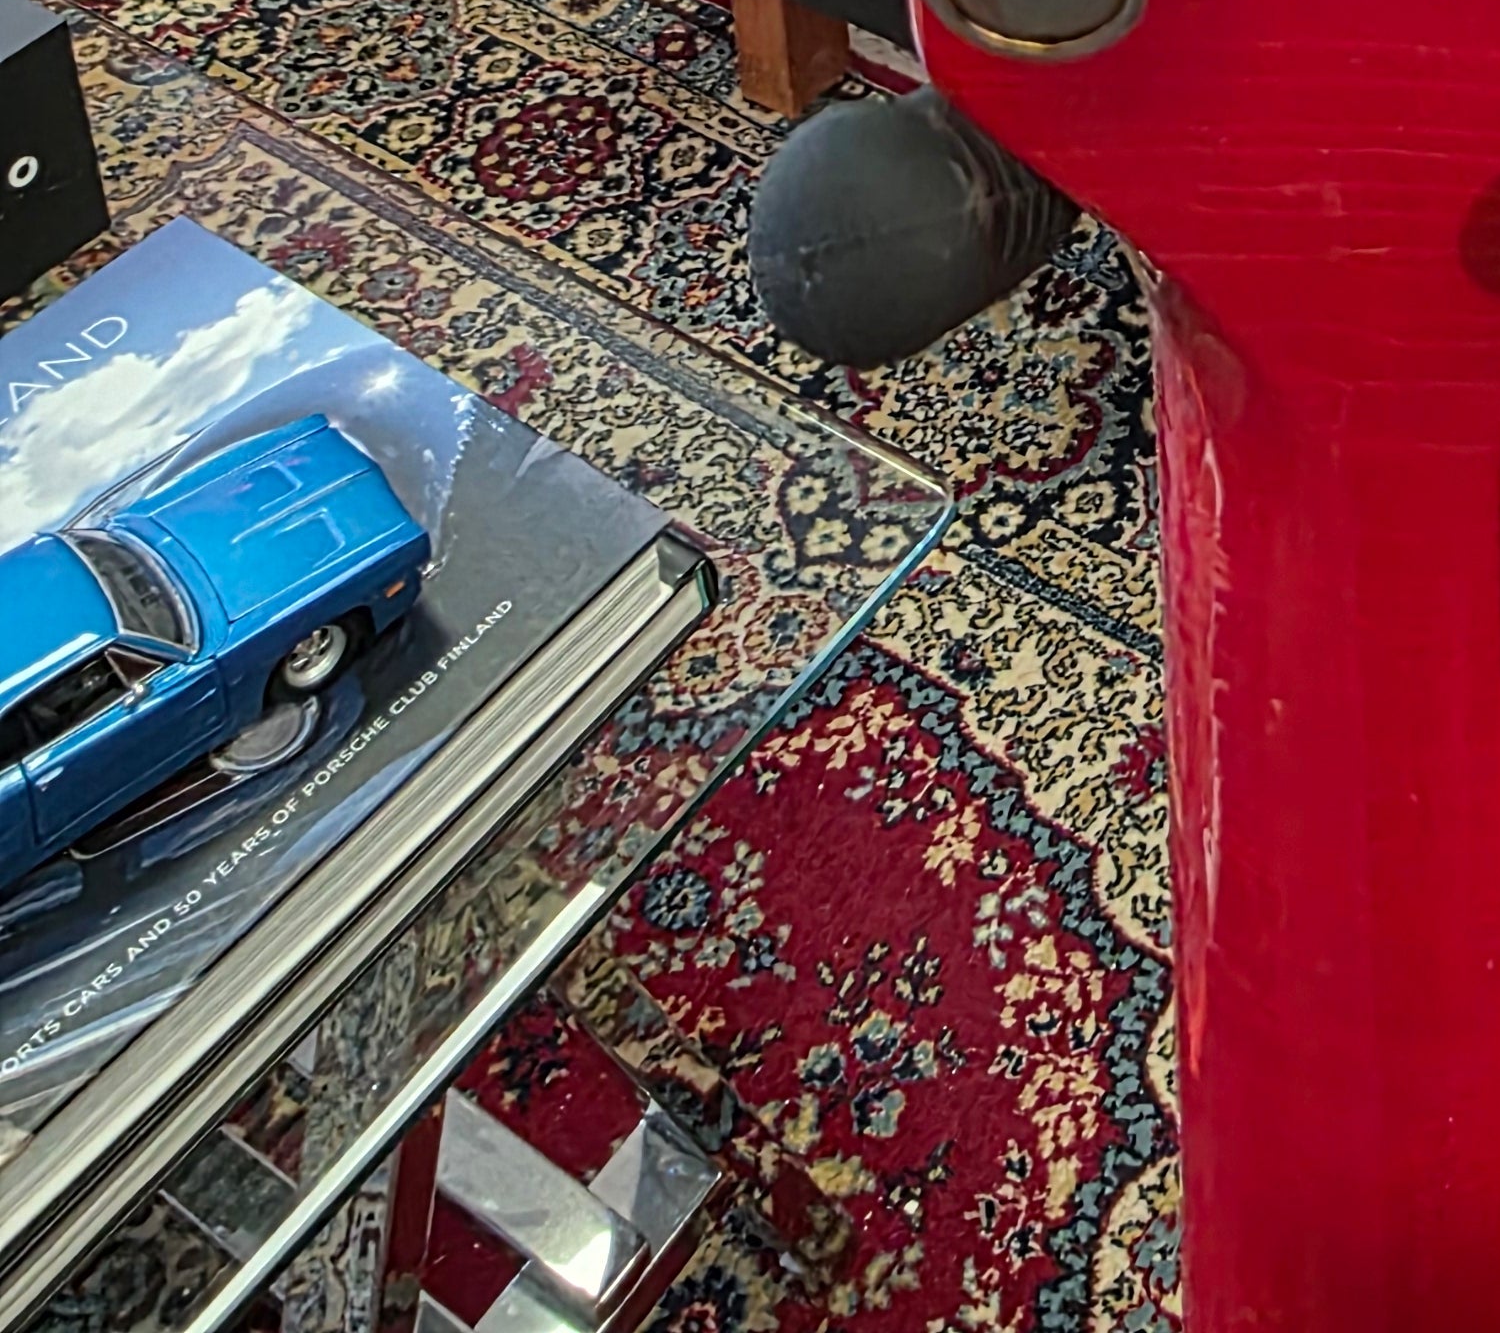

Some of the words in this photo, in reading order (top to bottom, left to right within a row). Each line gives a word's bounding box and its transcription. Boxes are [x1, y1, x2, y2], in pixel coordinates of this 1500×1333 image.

[0, 316, 128, 426] AND
[64, 963, 123, 1017] CARS
[127, 918, 171, 963] AND
[174, 889, 202, 917] 50
[203, 825, 271, 886] YEARS
[272, 797, 299, 825] OF
[302, 716, 390, 797] PORSCHE
[389, 670, 438, 716] CLUB
[437, 600, 513, 670] FINLAND
